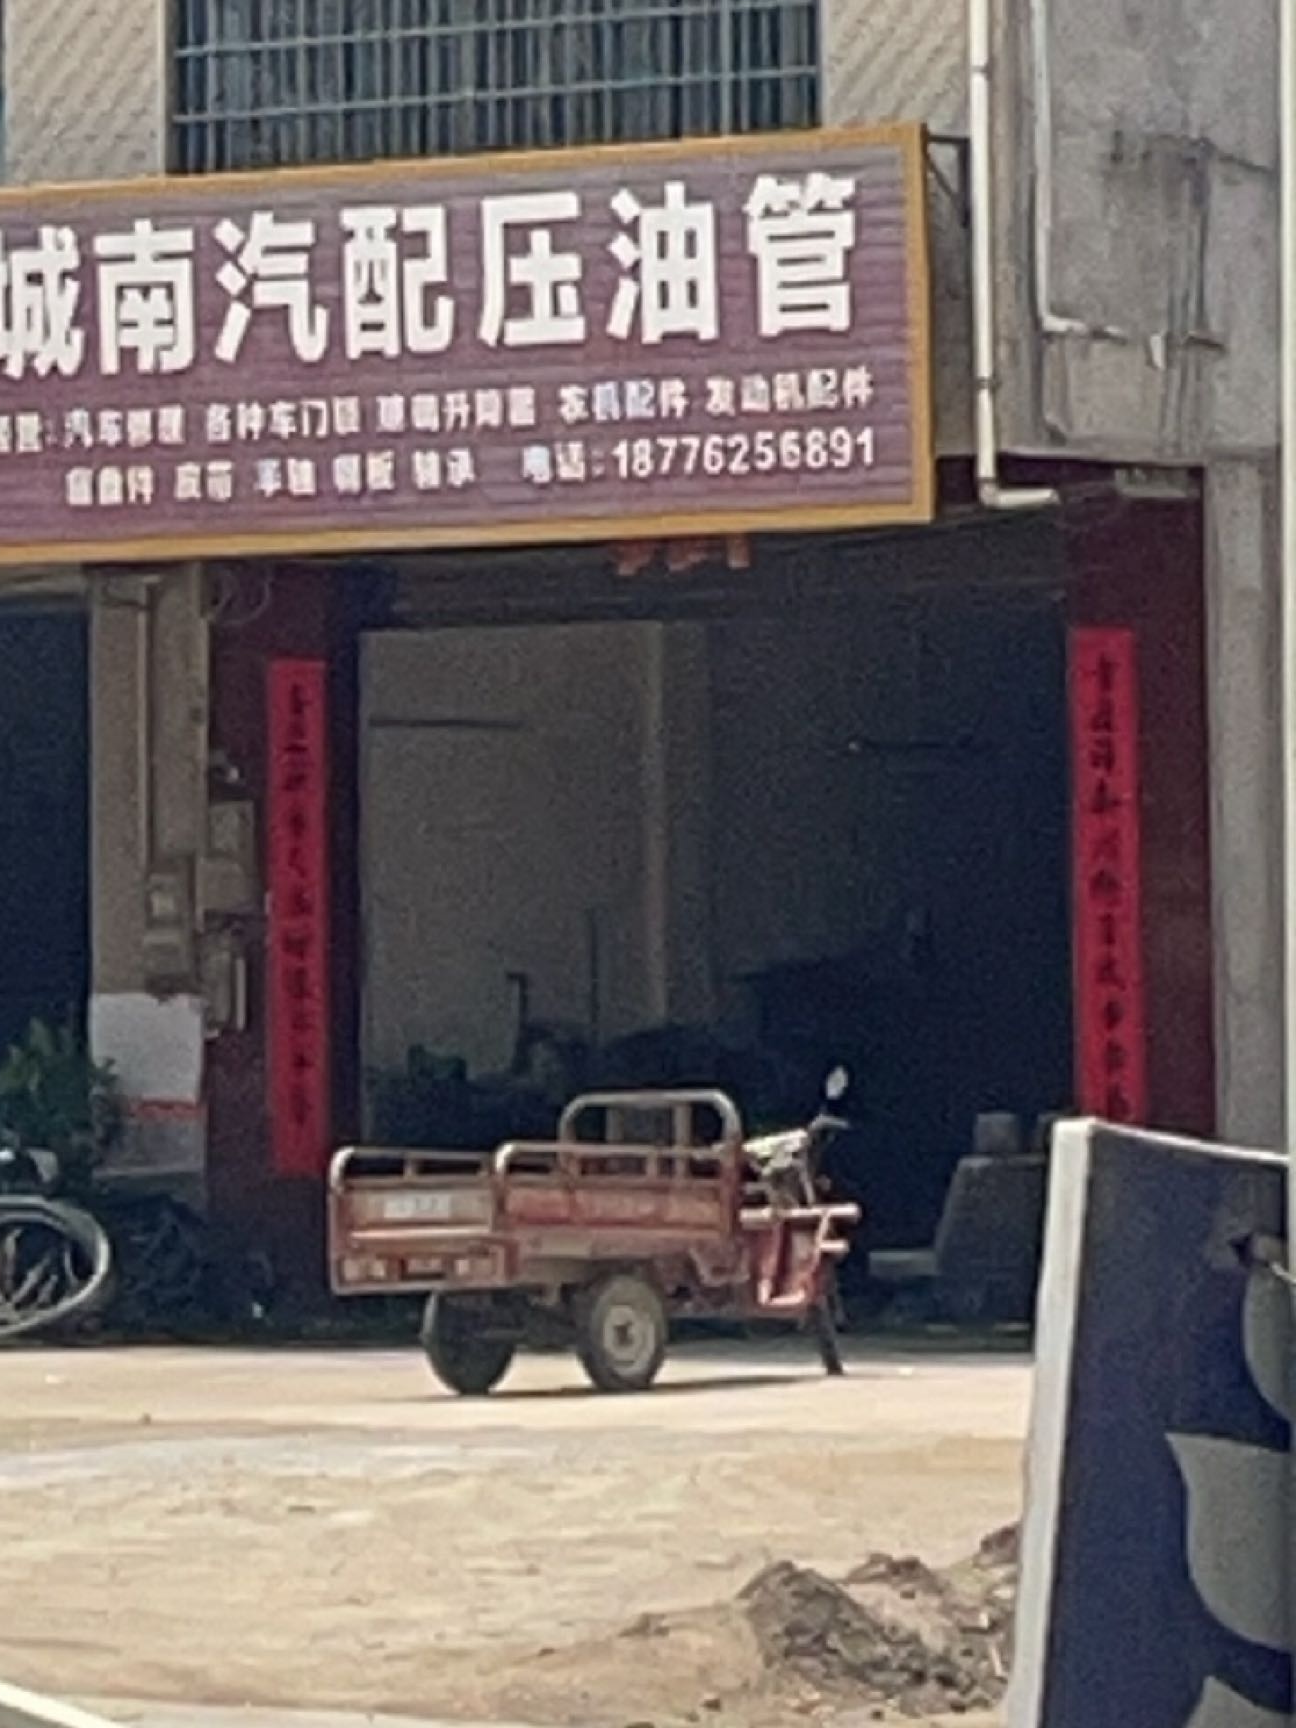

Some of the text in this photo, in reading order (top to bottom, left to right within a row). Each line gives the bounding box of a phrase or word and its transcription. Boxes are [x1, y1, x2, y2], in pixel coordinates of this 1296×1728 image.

[704, 365, 875, 416] 发动机配件
